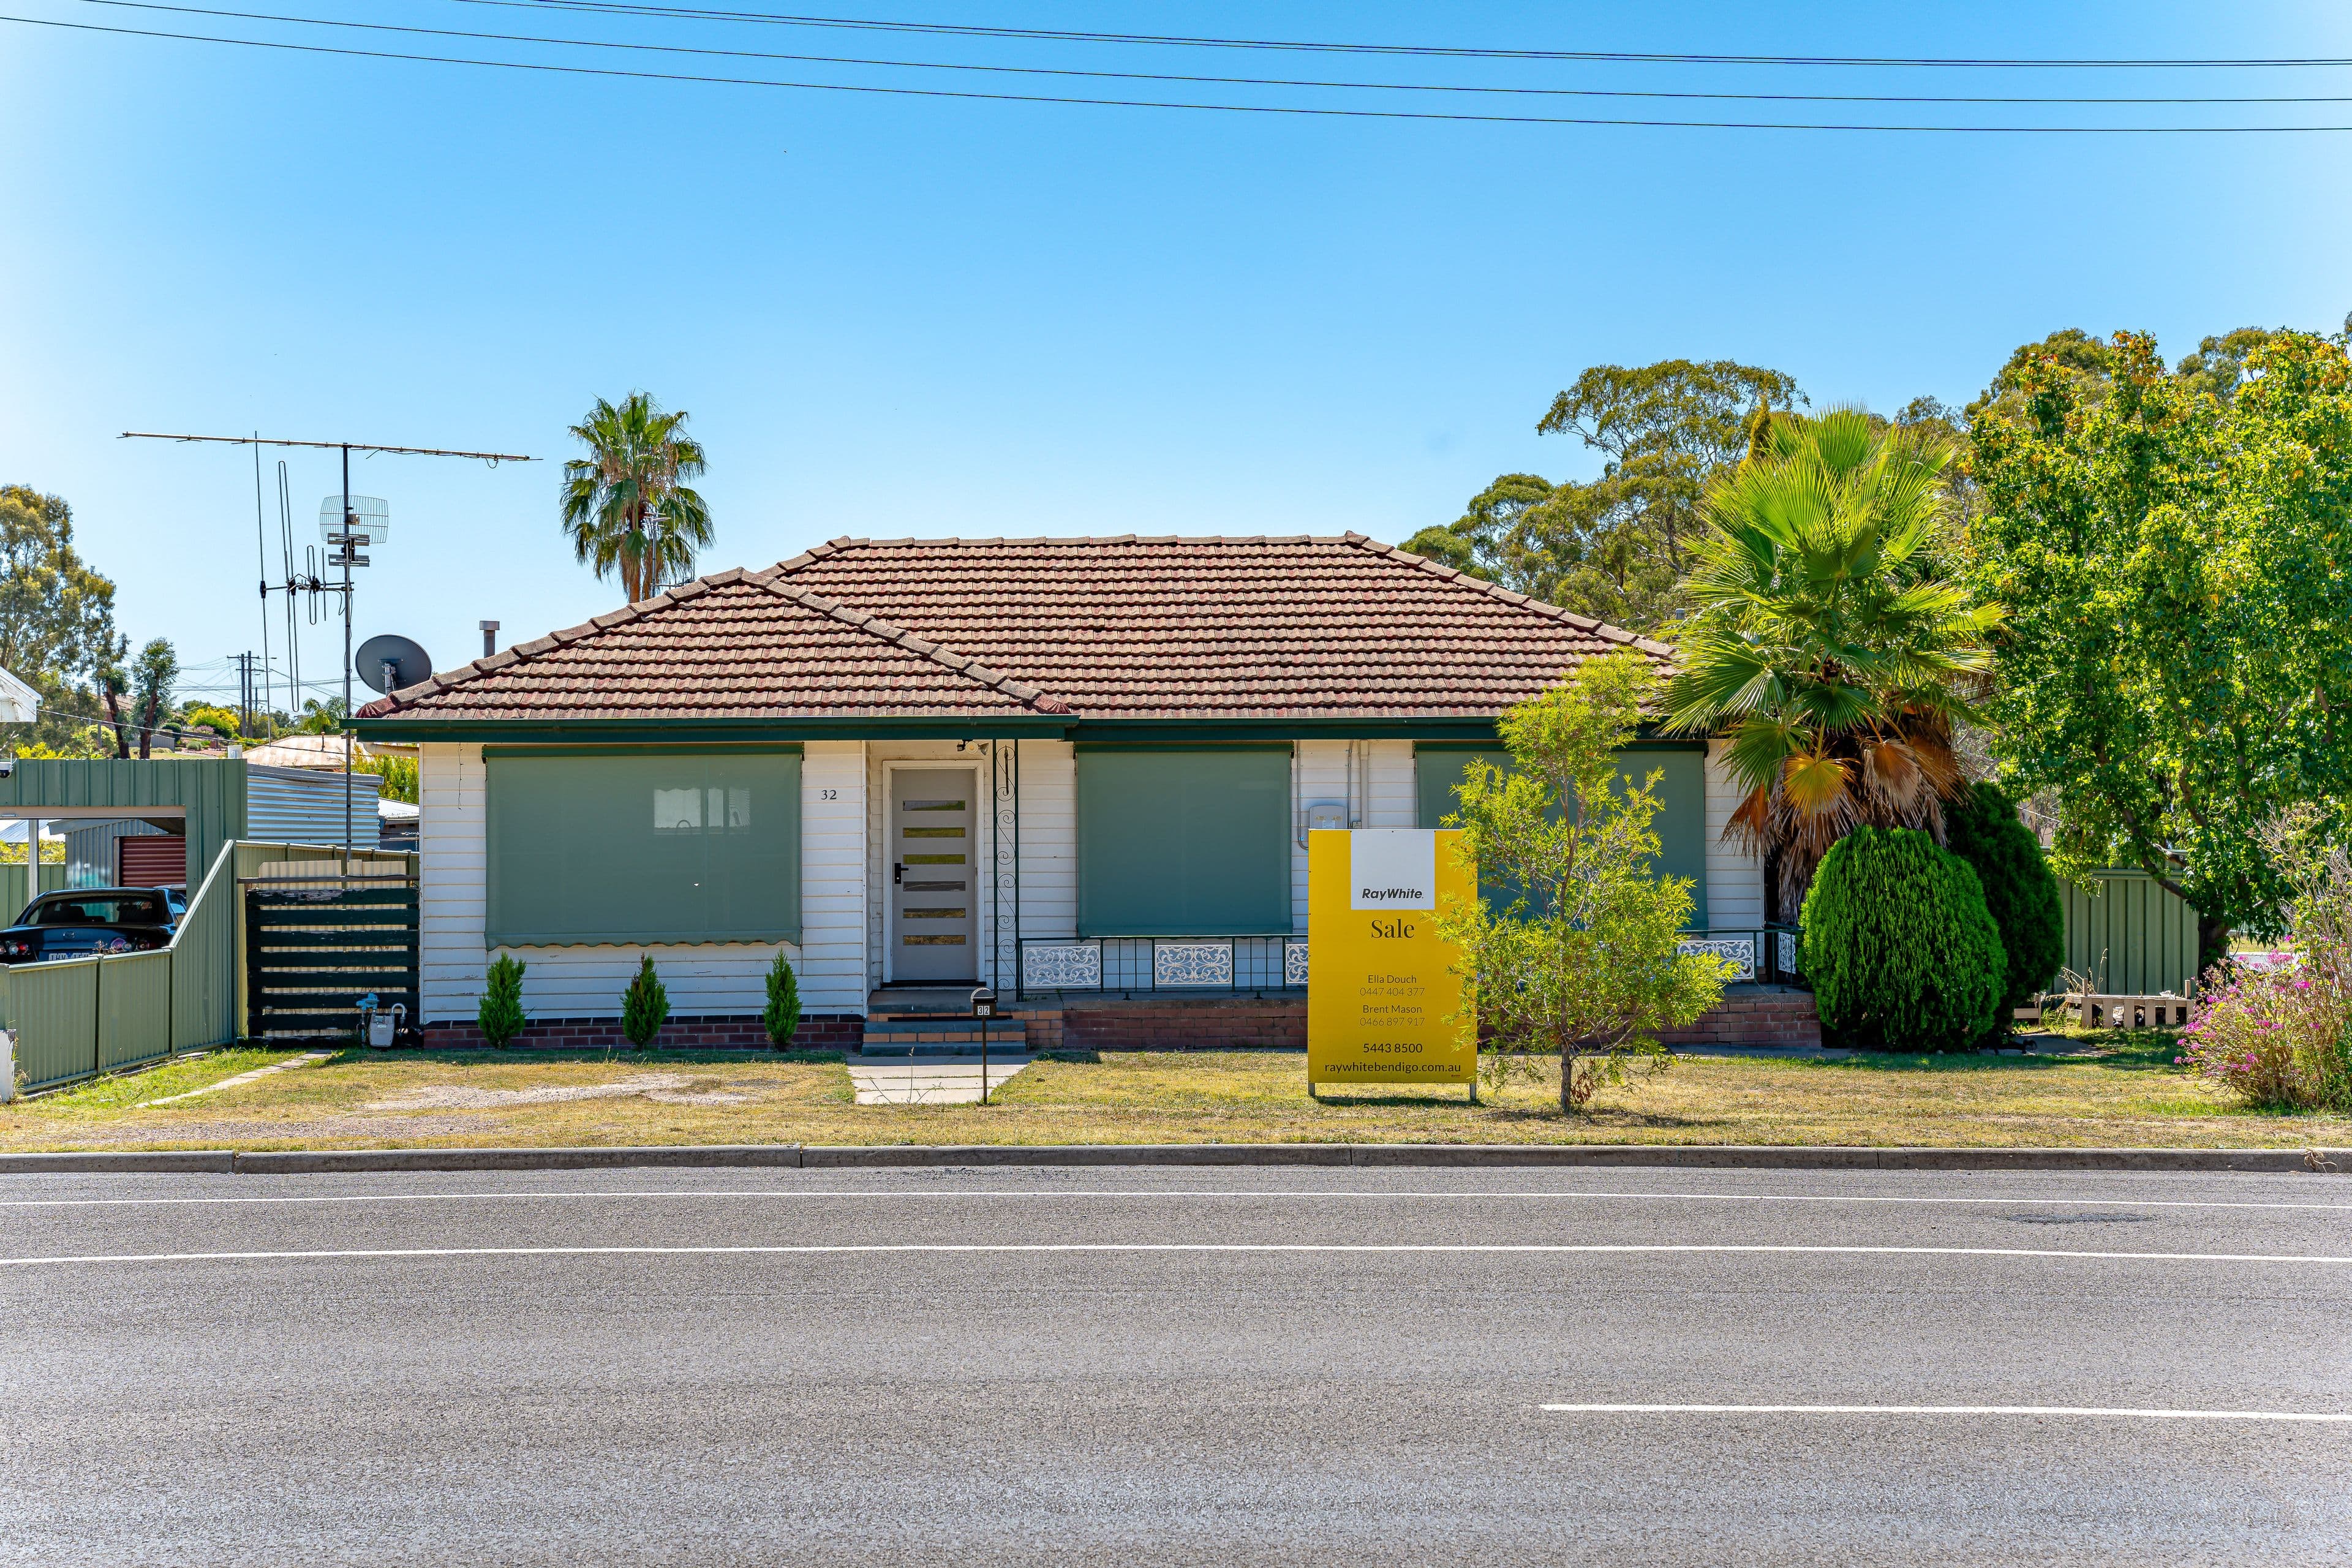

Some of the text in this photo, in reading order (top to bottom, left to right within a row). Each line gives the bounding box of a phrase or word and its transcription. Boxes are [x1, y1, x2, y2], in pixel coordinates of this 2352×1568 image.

[821, 790, 837, 800] 32
[1371, 919, 1415, 938] Sale
[1368, 974, 1417, 984] Ella Douch
[1360, 987, 1425, 996] 0447 404 377
[1363, 1005, 1422, 1013] Brent Mason
[1360, 1017, 1425, 1026] 0466 897 917
[1363, 1043, 1423, 1053] 5443 8500
[1324, 1061, 1461, 1074] raywhitebendigo.com.au
